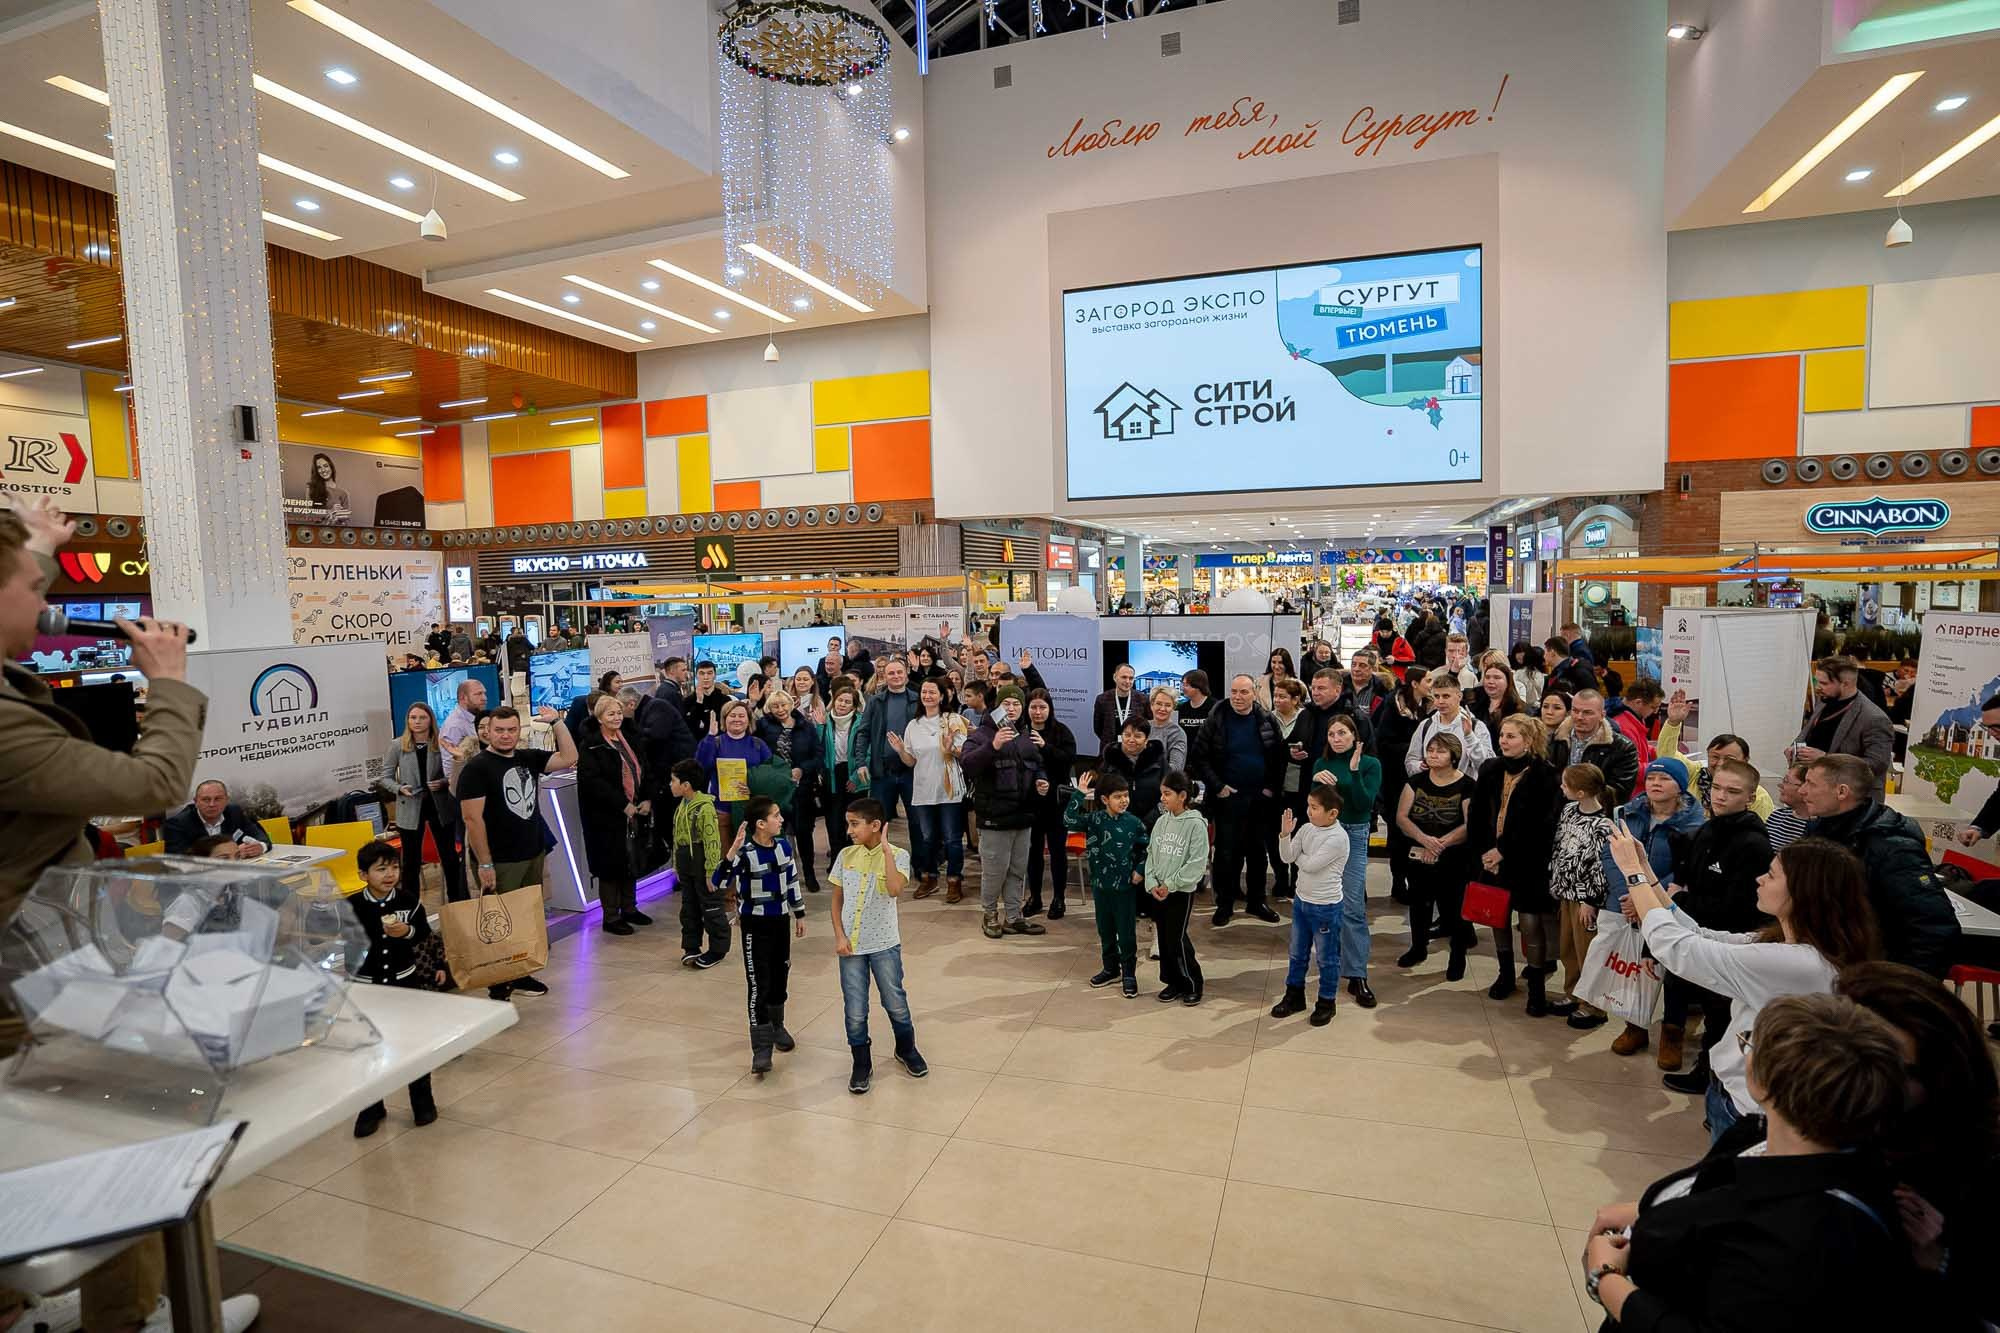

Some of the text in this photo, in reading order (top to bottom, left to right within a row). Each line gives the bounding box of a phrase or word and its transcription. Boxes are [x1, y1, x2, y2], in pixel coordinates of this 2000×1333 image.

[1047, 96, 1279, 158] Люблю тебя,
[1237, 74, 1509, 160] мой Сургут!
[1337, 281, 1440, 306] СУРГУТ
[1075, 289, 1265, 324] ЗАГОРОД ЭКСПО
[1319, 305, 1357, 316] ВПЕРВЫЕ!
[1091, 310, 1248, 334] выставка загородной жизни
[1345, 314, 1439, 344] ТЮМЕНЬ
[1194, 379, 1273, 405] СИТИ
[1194, 395, 1297, 427] СТРОЙ
[1449, 448, 1471, 467] 0+
[0, 483, 72, 496] ROSTIC'S
[513, 556, 570, 573] ВКУСНО
[596, 552, 649, 569] ТОЧКА
[1232, 552, 1313, 565] гипер лента
[311, 564, 403, 581] ГУЛЕНЬКИ
[331, 612, 393, 630] СКОРО
[1948, 624, 2000, 639] партне
[241, 711, 329, 733] ГУДВИЛЛ
[299, 723, 369, 743] ЗАГОРОДНОЙ
[240, 739, 336, 762] НЕДВИЖИМОСТИ
